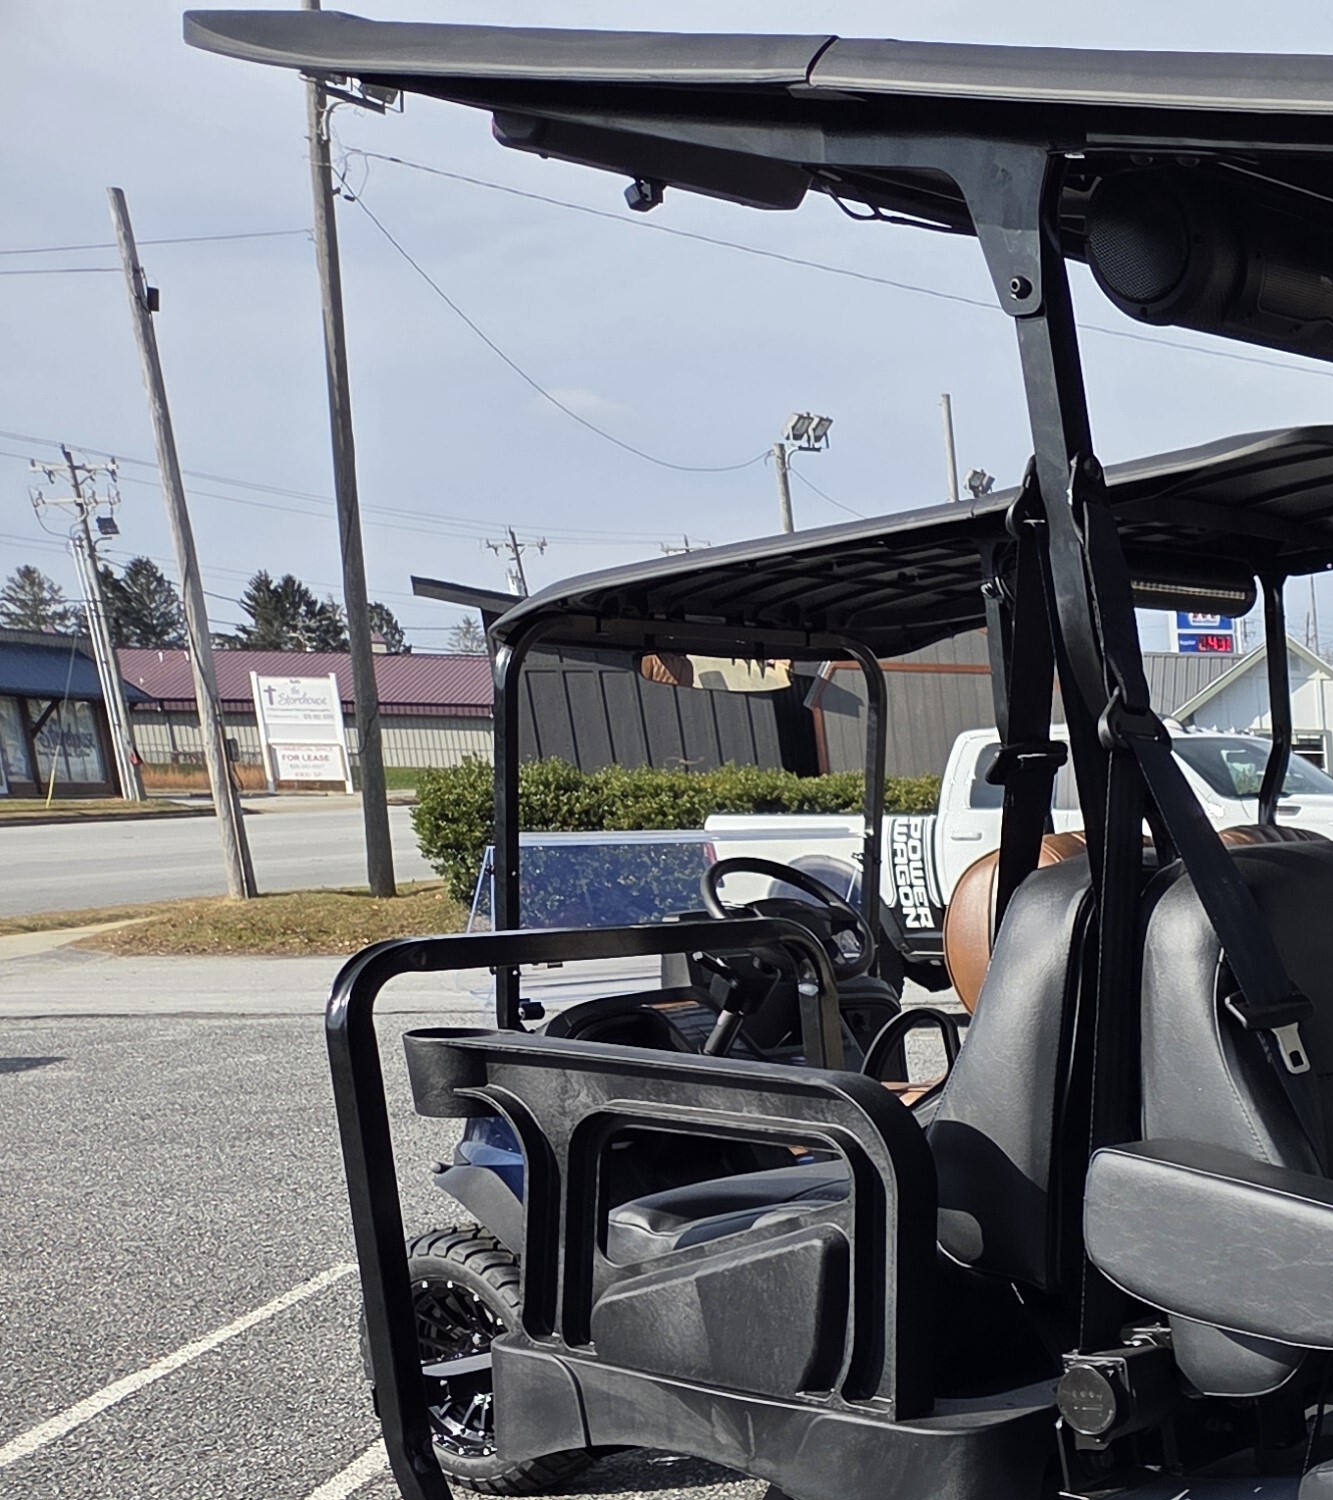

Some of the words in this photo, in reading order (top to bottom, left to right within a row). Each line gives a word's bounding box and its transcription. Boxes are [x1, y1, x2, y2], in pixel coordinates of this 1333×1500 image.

[282, 754, 300, 762] FOR
[301, 754, 330, 762] LEASE
[892, 819, 921, 928] WAGON
[907, 816, 935, 928] POWER
